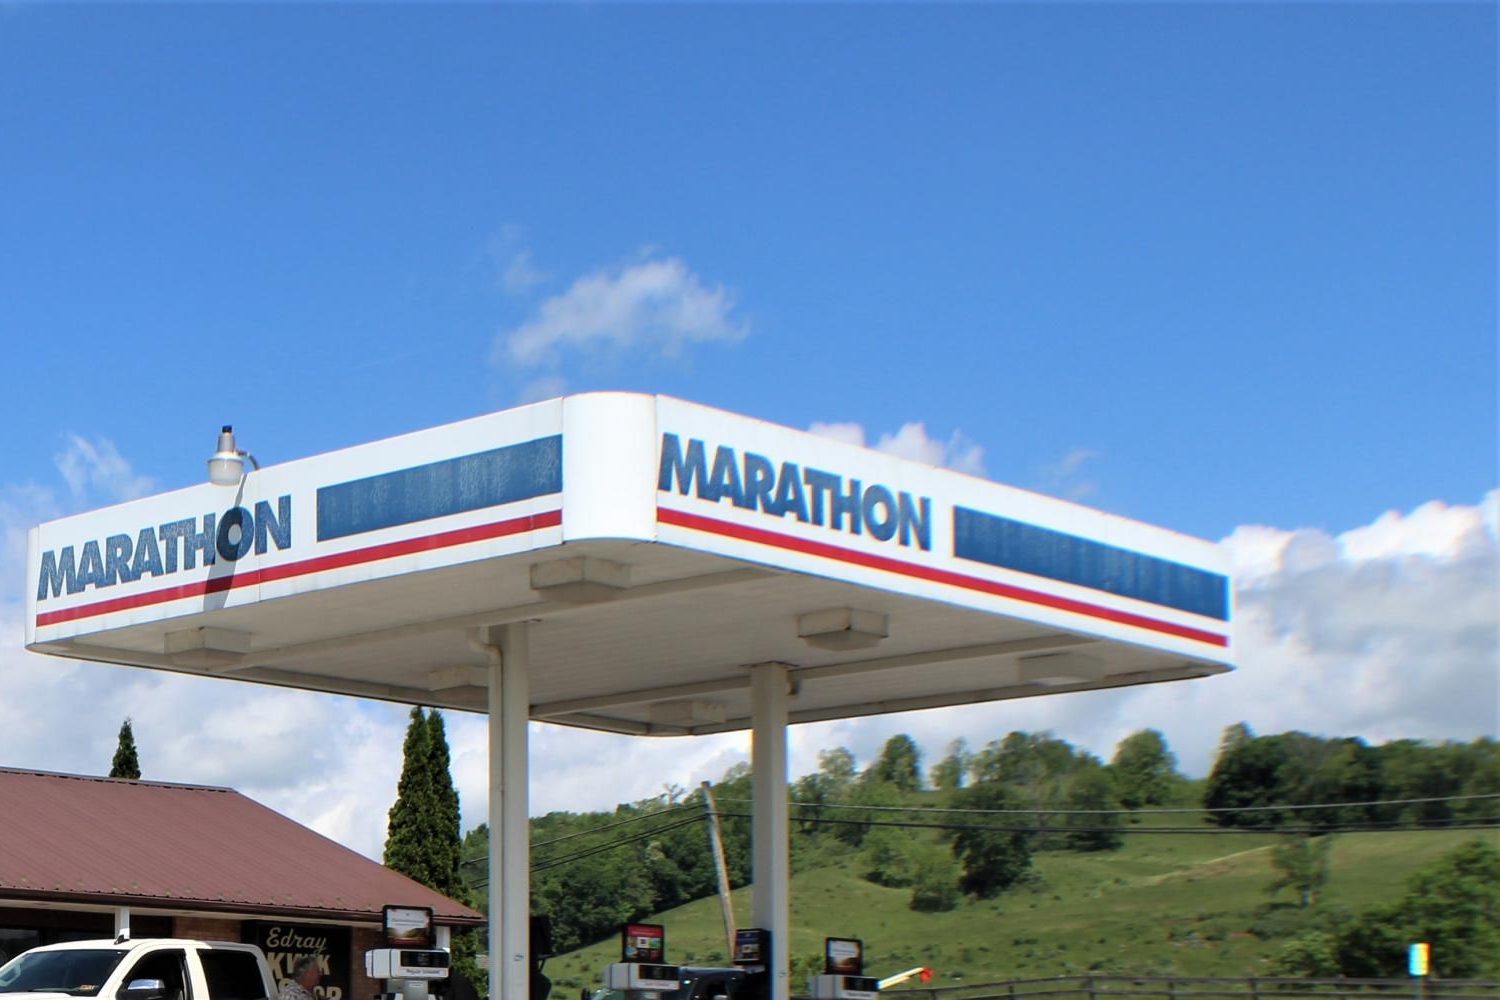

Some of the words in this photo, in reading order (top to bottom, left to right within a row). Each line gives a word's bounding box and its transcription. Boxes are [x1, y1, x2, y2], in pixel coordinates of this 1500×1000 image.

[657, 432, 931, 552] MARATHON
[37, 494, 292, 601] MARATHON
[266, 927, 328, 956] Edray
